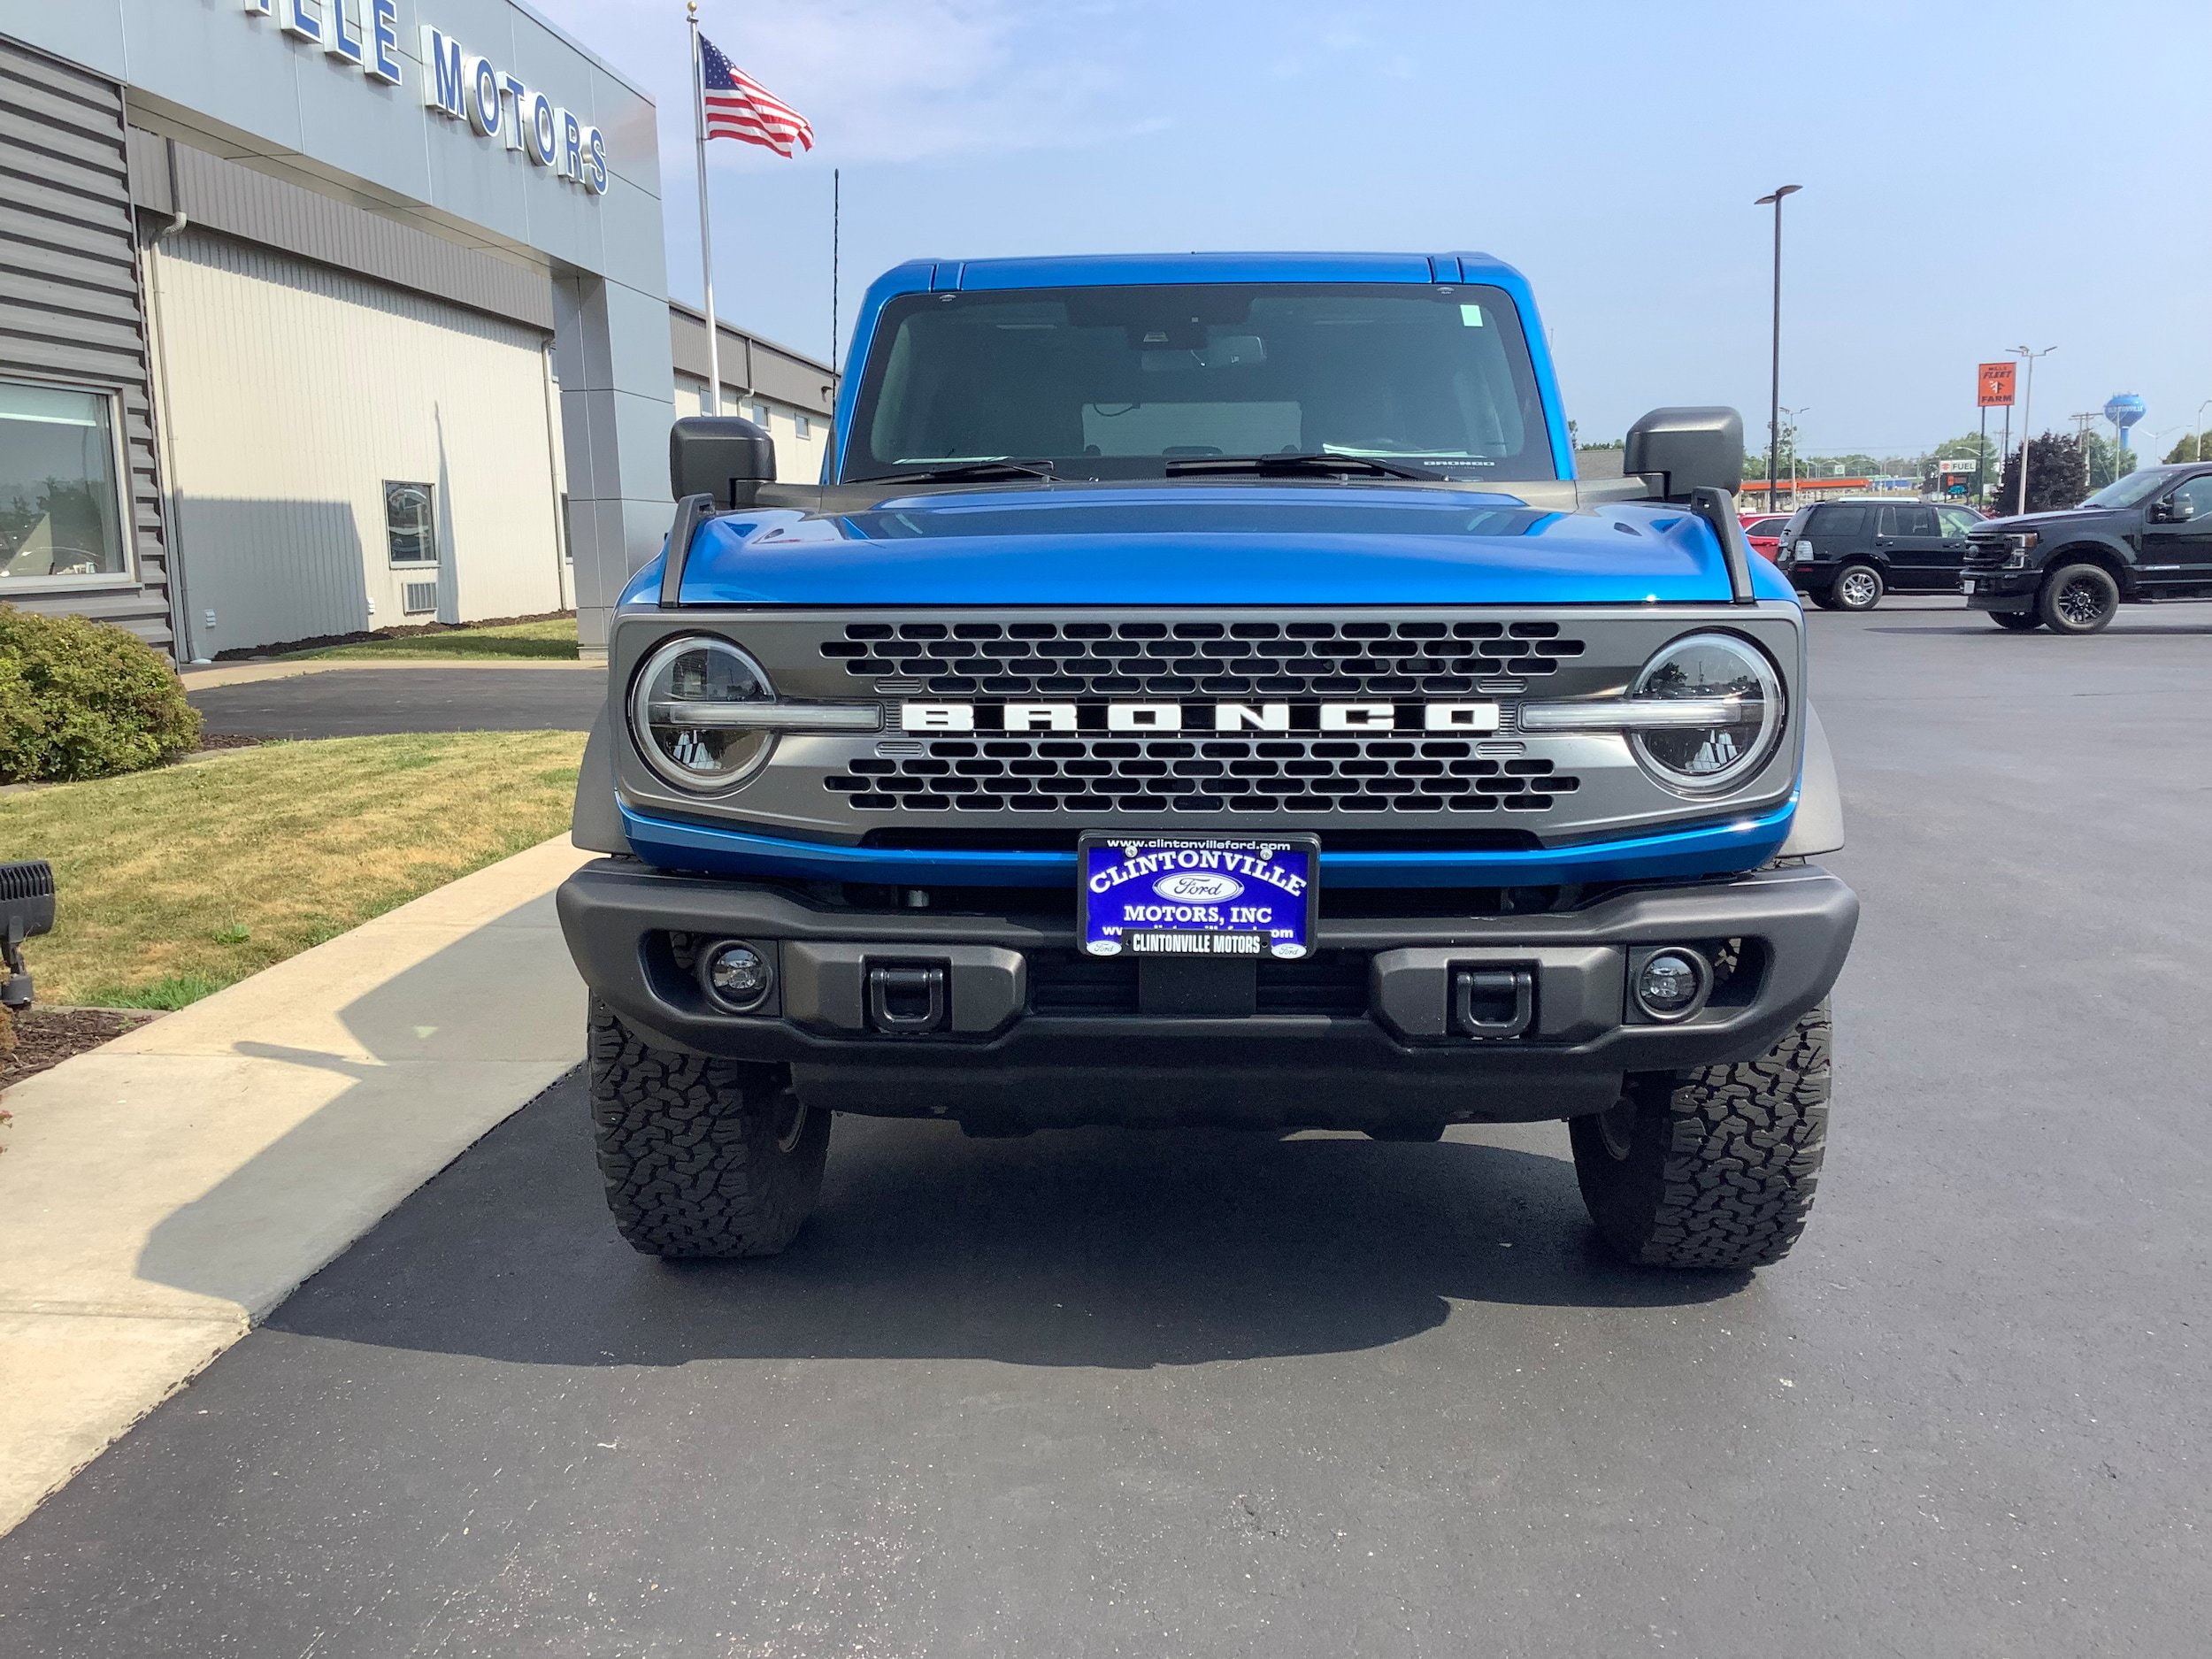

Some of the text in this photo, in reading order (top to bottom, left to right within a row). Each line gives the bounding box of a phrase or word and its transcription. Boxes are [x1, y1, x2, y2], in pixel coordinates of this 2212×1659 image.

[245, 0, 609, 196] LLE MOTORS
[901, 703, 1501, 732] BRONCO
[1107, 839, 1291, 851] www.clintonvilleford.com
[1089, 850, 1307, 897] CLINTONVILLE
[1174, 877, 1222, 896] Ford
[1123, 905, 1272, 924] MOTORS, INC
[1133, 933, 1261, 954] CLINTONVILLE MOTORS
